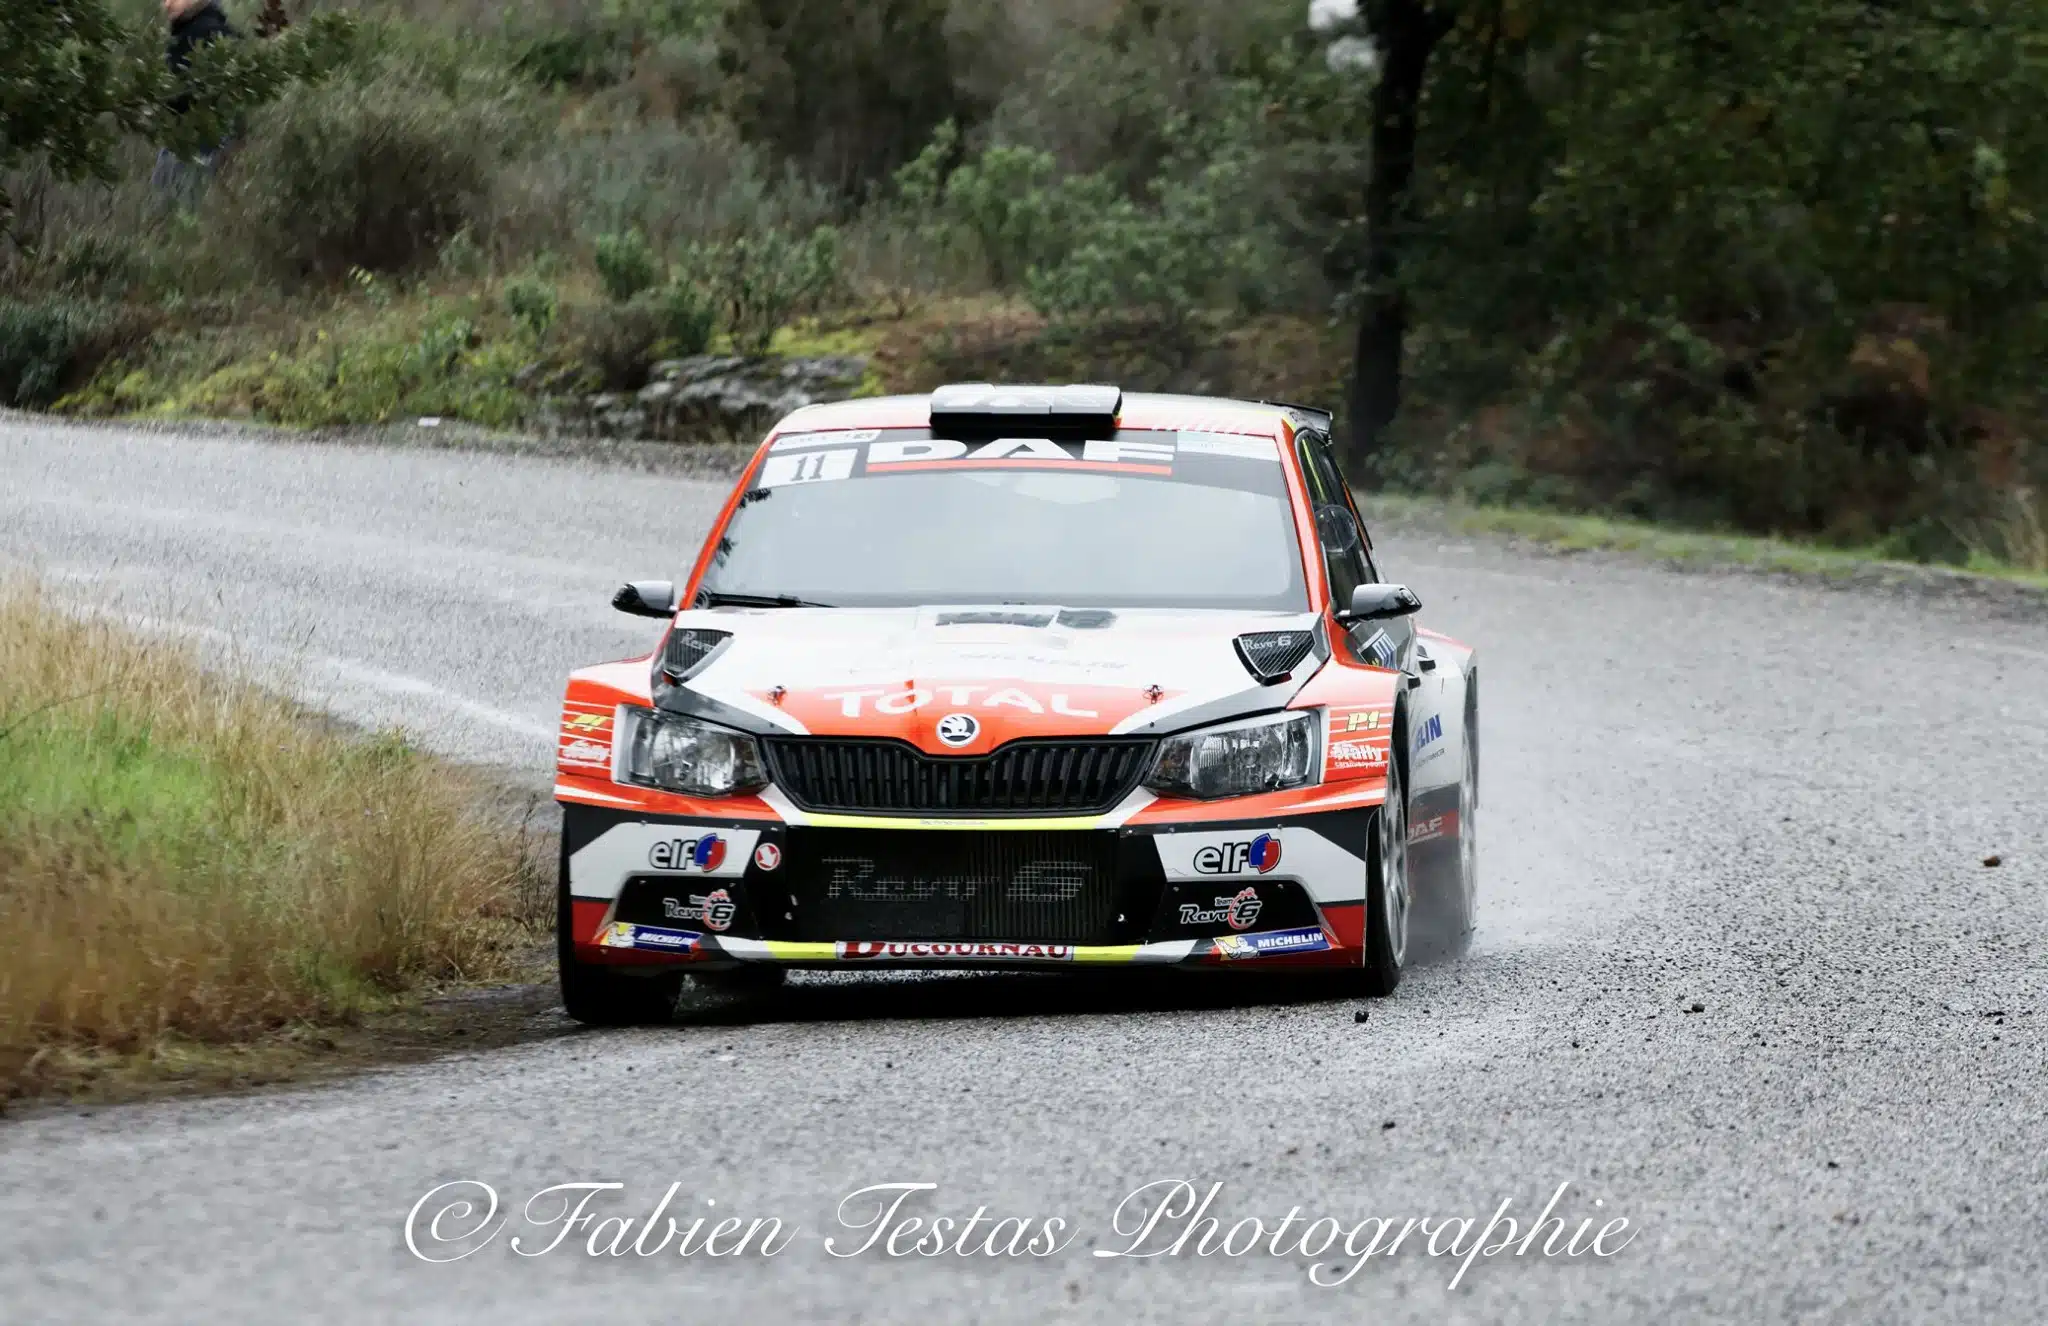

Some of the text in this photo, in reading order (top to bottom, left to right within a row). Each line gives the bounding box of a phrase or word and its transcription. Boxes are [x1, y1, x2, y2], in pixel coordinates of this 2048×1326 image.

[867, 438, 1175, 463] DAF
[790, 453, 827, 482] 11
[823, 685, 1099, 718] TOTAL
[649, 839, 698, 870] elf
[1193, 842, 1251, 875] elf
[1256, 931, 1324, 949] MICHELIN
